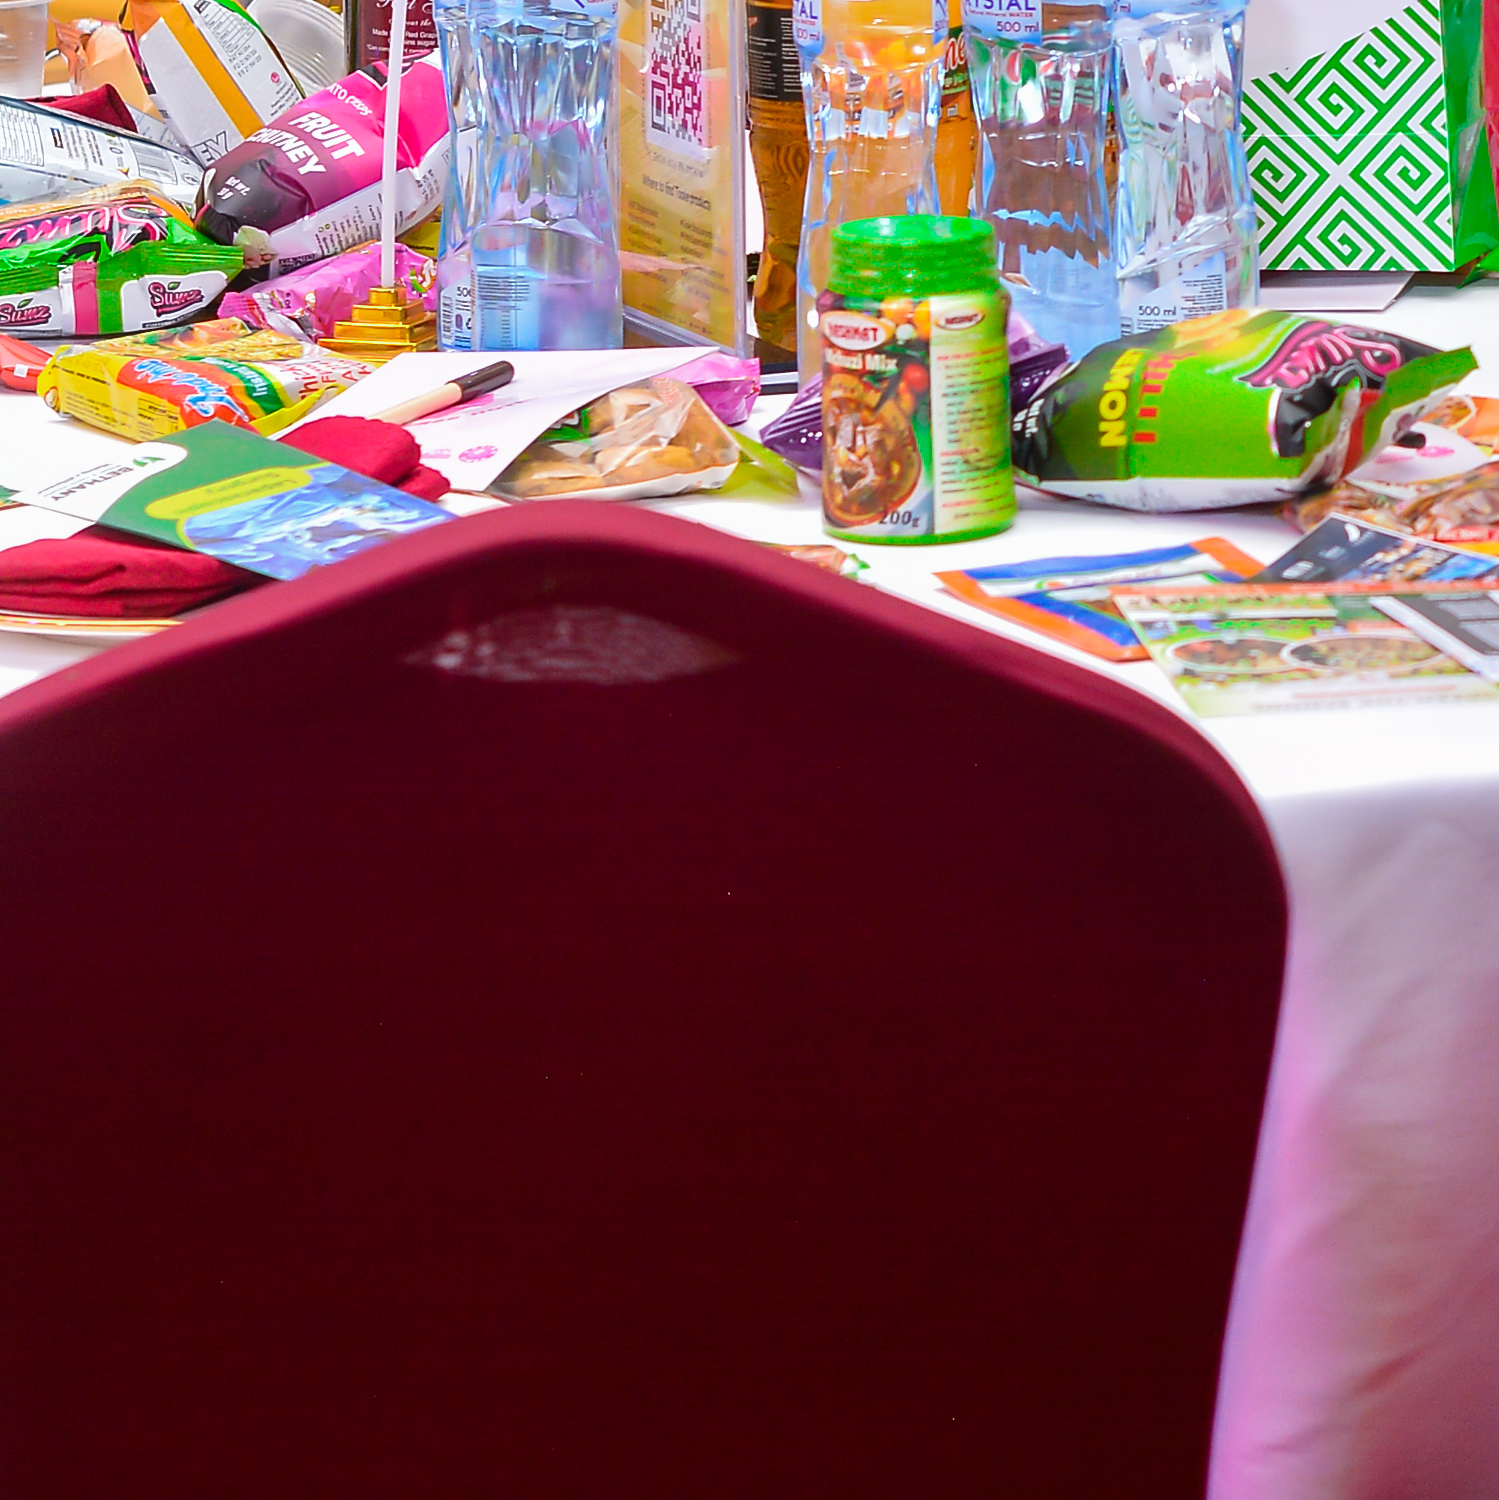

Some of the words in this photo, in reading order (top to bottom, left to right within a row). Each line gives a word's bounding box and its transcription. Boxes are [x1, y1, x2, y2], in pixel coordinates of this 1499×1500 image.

[997, 20, 1021, 32] 500
[1025, 21, 1039, 32] ml
[417, 39, 436, 48] sugar
[288, 111, 366, 160] FRUIT
[149, 282, 204, 306] Sumz
[0, 302, 52, 324] Sumz
[1139, 306, 1160, 316] 500
[1163, 306, 1177, 316] ml
[51, 465, 135, 502] BETHANY
